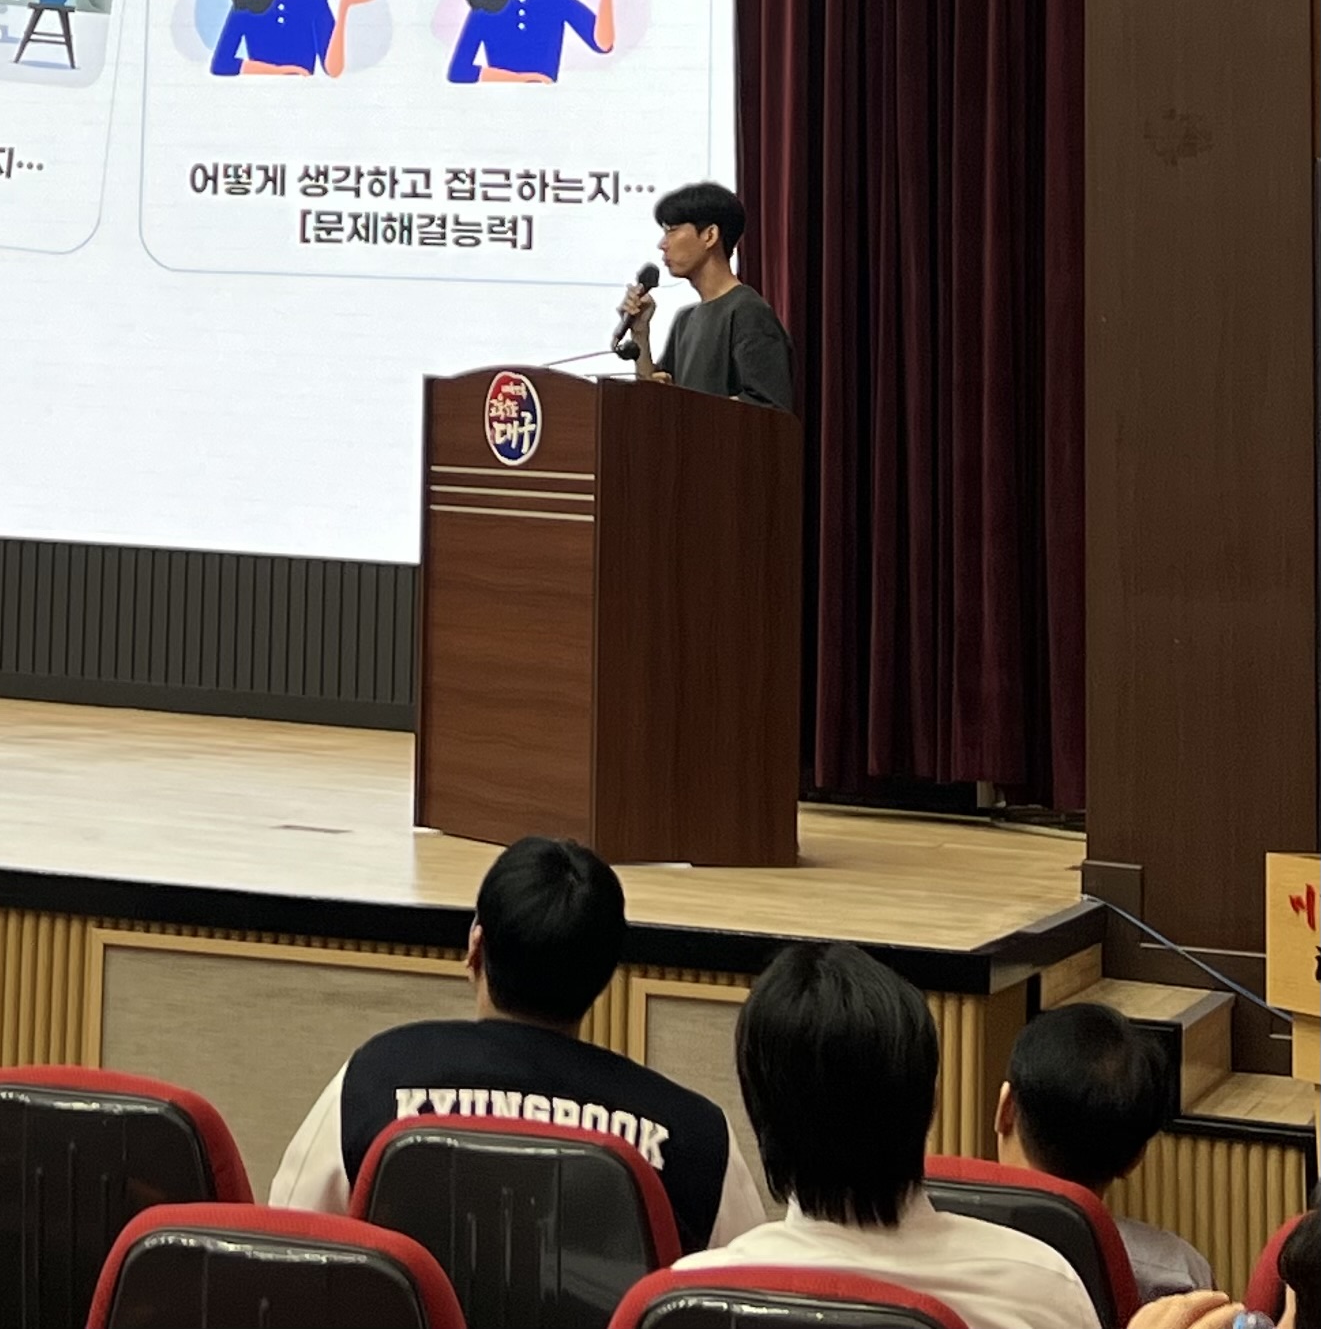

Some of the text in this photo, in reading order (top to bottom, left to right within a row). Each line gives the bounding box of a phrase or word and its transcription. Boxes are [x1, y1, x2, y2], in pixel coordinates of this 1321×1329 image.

[189, 162, 287, 197] 어떻게
[297, 163, 434, 200] 생각하고
[299, 208, 534, 250] [문제해결능력]
[492, 411, 536, 454] 대구
